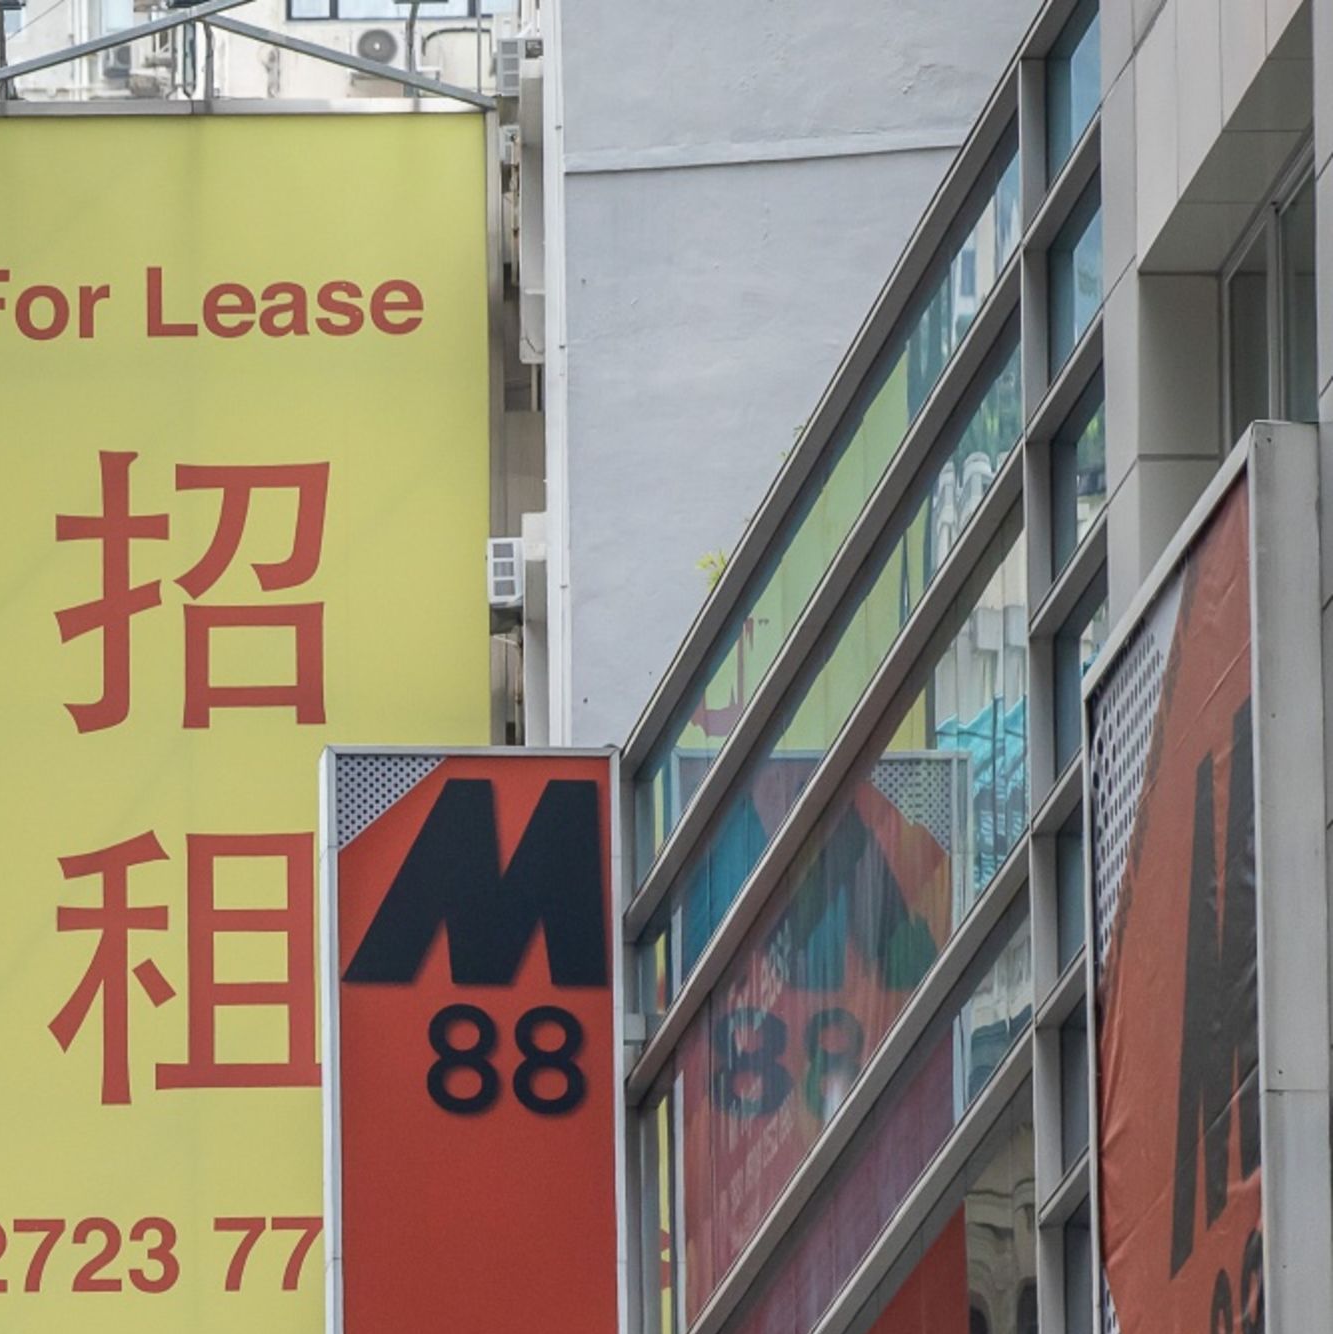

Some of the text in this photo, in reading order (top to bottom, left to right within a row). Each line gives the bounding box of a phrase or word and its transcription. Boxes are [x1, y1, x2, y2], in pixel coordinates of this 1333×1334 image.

[145, 266, 425, 338] Lease
[47, 450, 331, 1105] 招租
[341, 778, 608, 987] M
[426, 1003, 587, 1117] 88
[213, 1217, 324, 1291] 77
